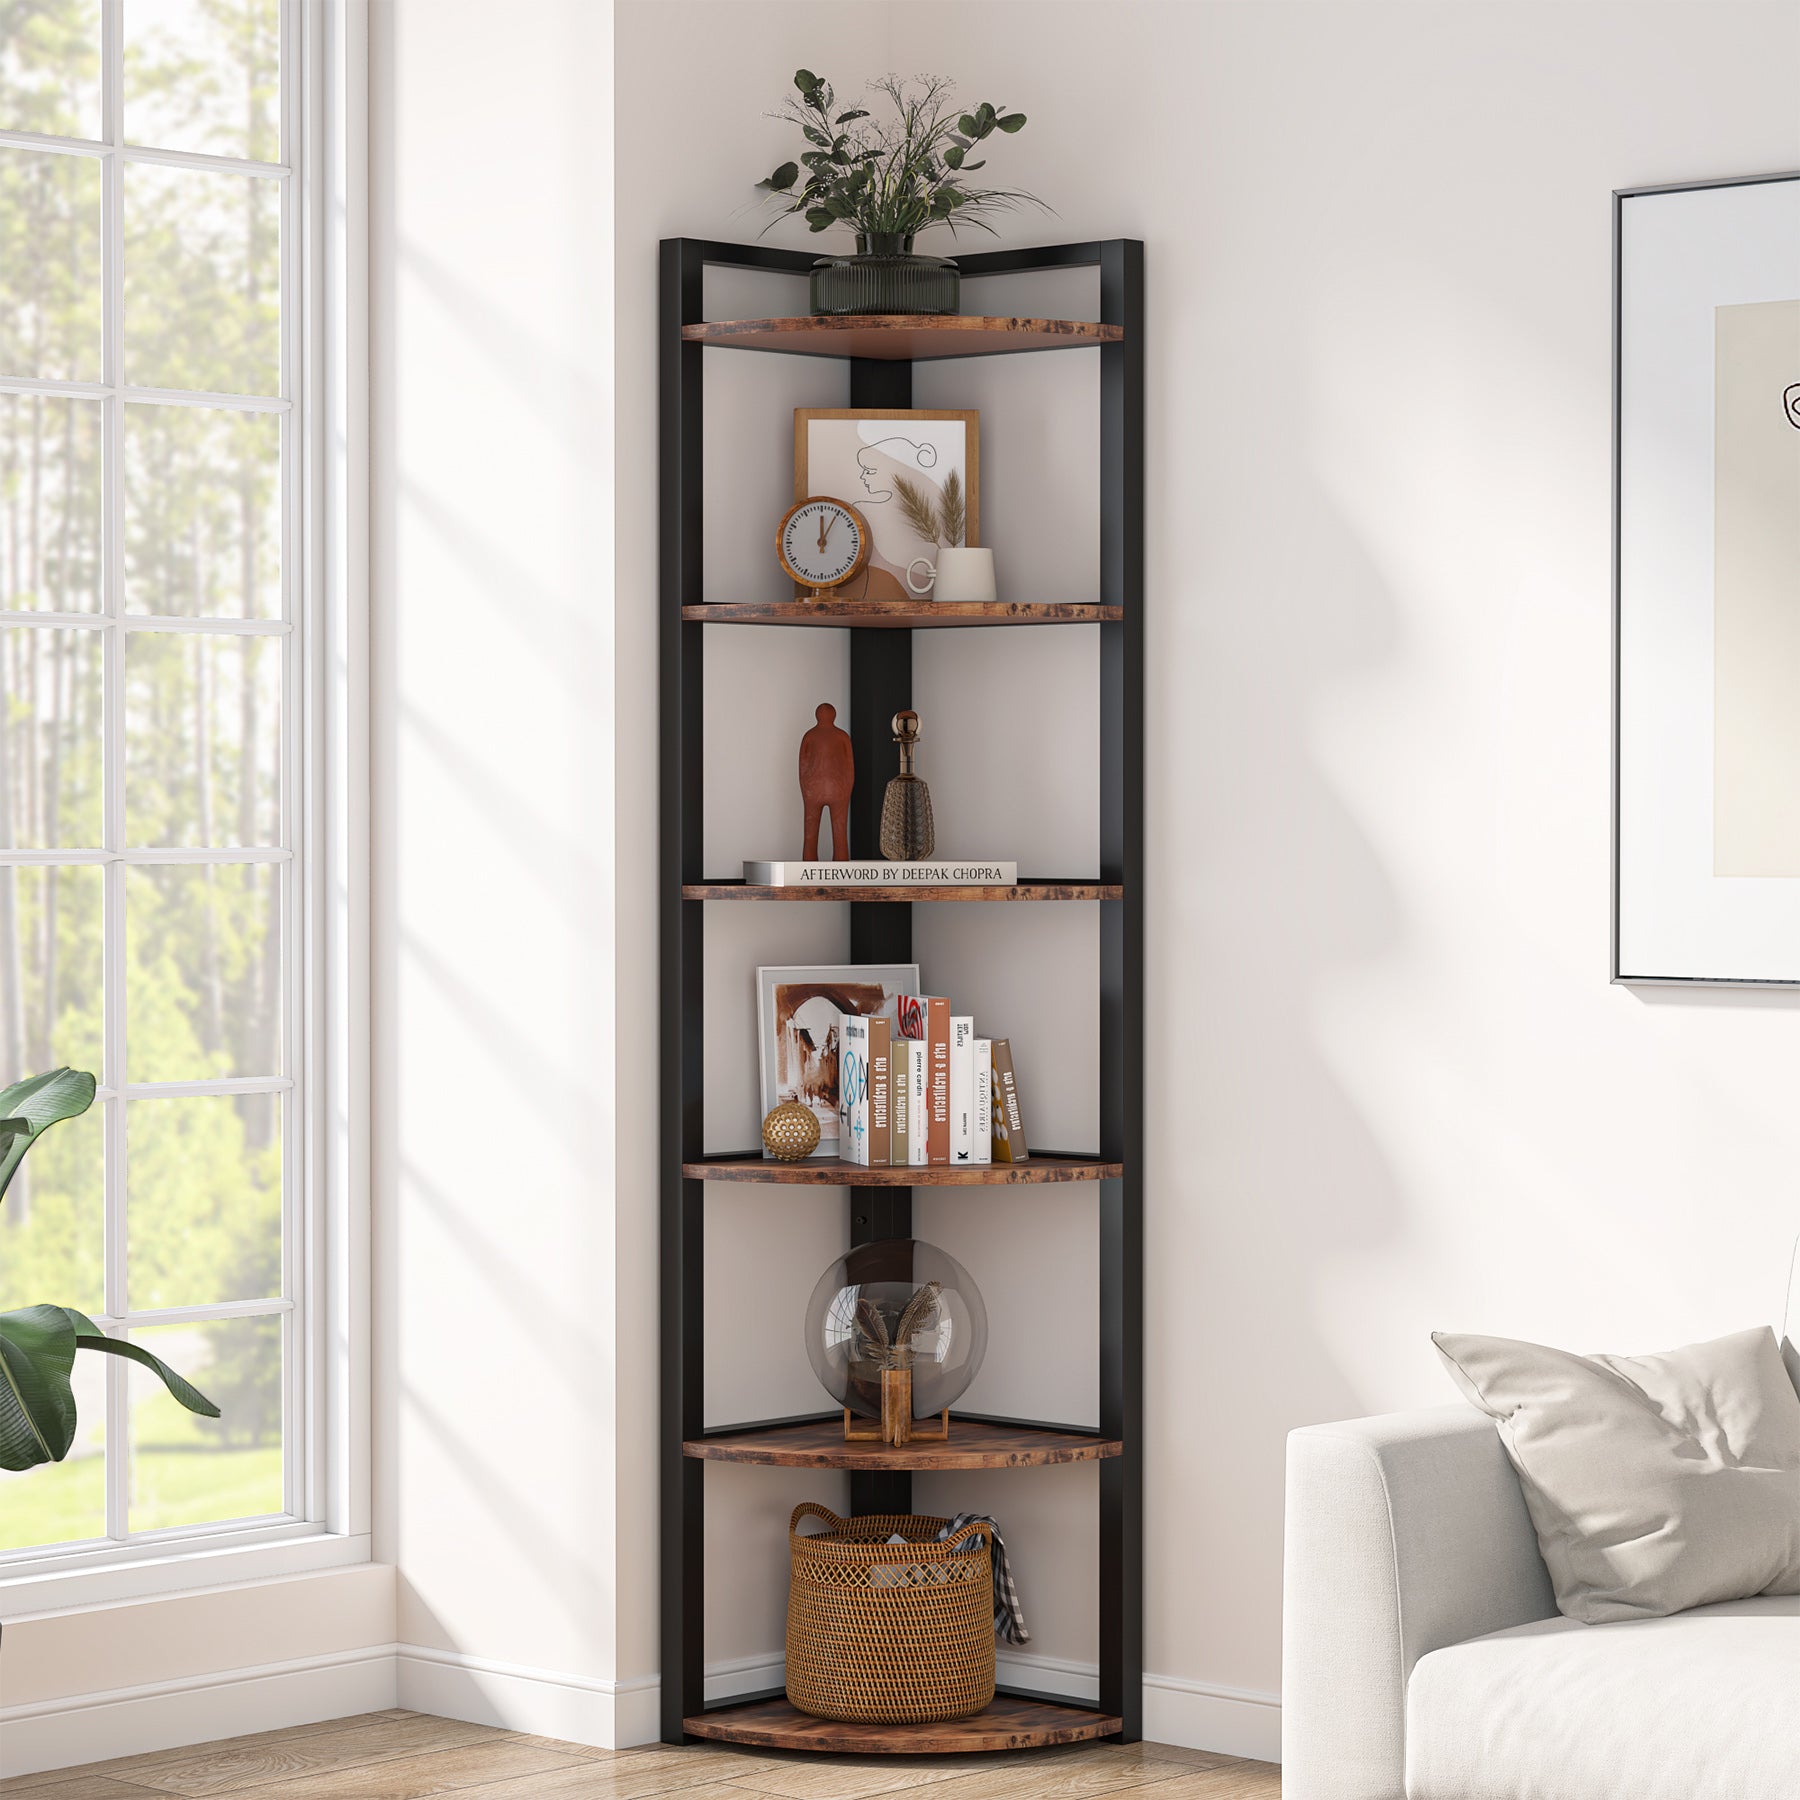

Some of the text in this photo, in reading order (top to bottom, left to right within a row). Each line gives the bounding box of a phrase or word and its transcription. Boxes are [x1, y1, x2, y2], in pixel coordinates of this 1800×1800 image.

[800, 867, 1002, 881] AFTERWORD BY DEEPAK CHOPRA
